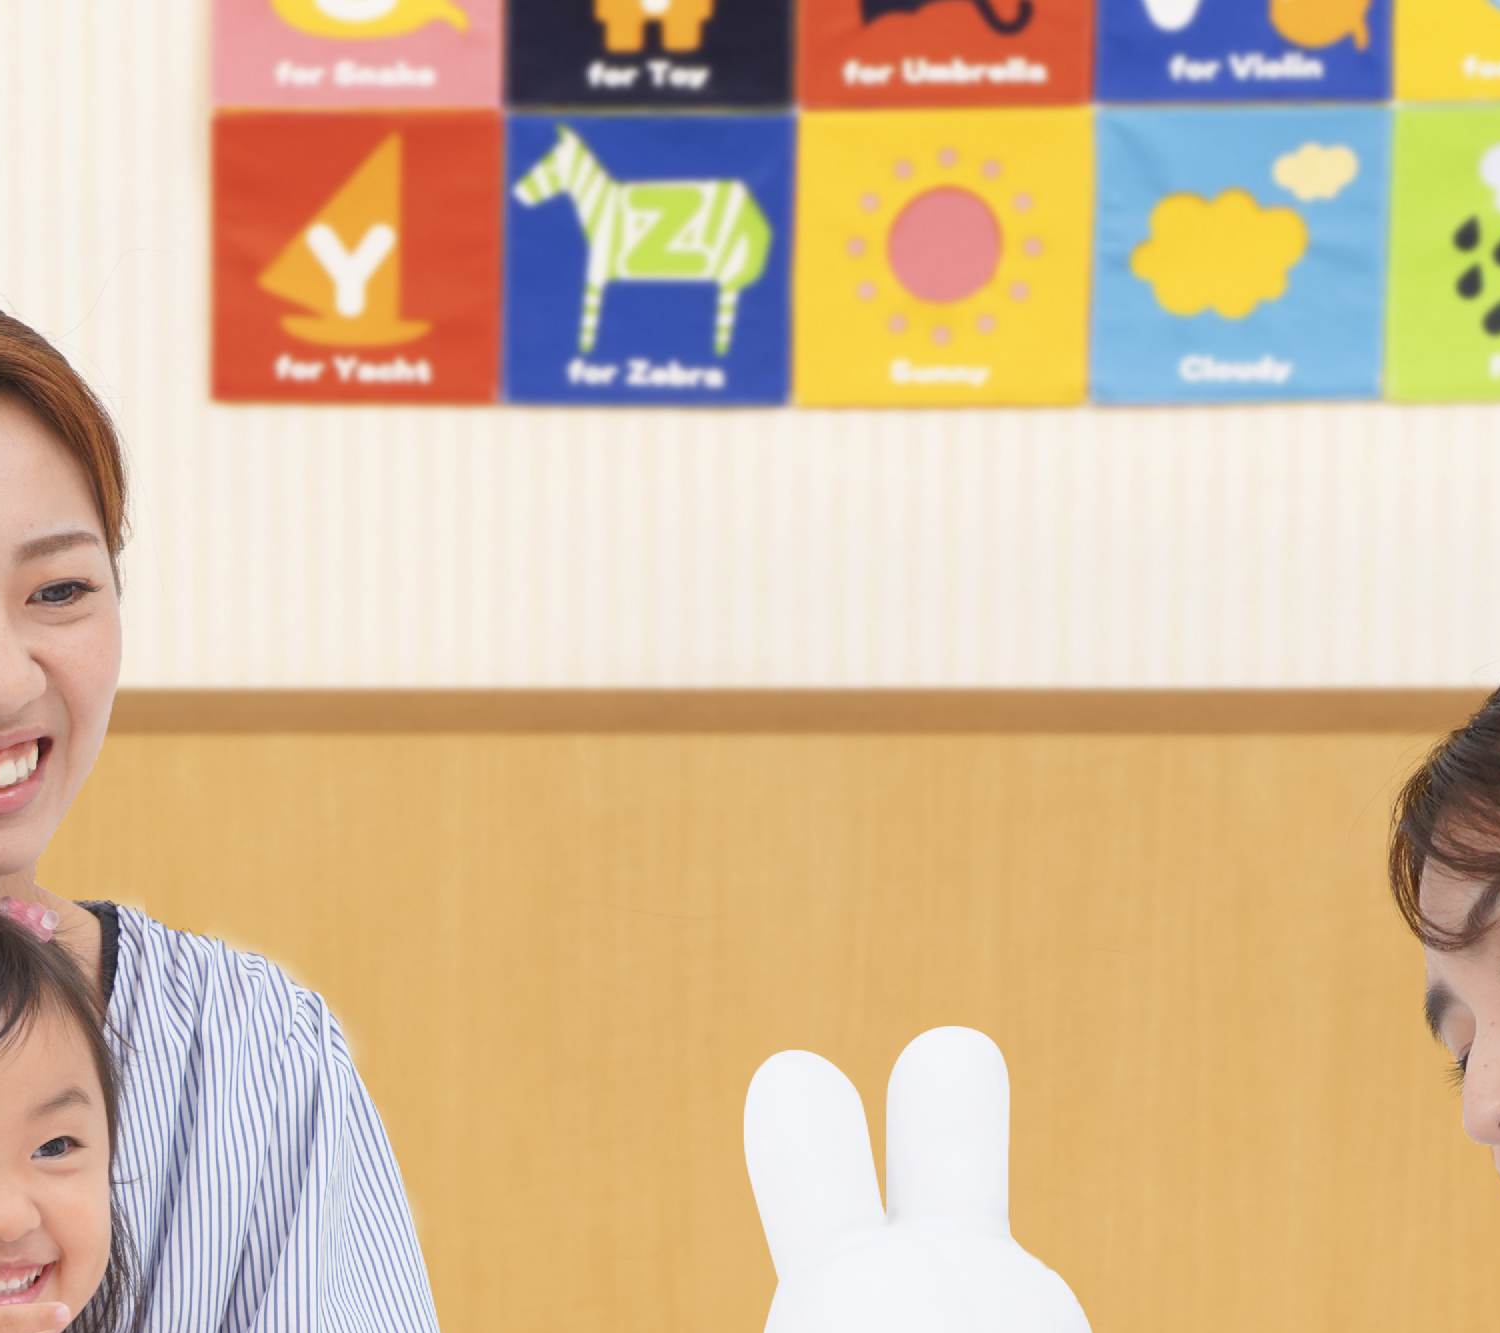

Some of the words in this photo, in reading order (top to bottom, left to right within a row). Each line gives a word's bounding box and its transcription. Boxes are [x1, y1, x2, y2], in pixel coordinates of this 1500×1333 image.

[274, 60, 325, 87] for
[332, 59, 437, 88] Snake
[586, 60, 638, 88] for
[646, 58, 709, 90] Toy
[841, 59, 893, 86] for
[900, 56, 1048, 85] Umbrella
[1168, 54, 1221, 82] for
[1227, 51, 1325, 80] Violin
[623, 186, 709, 277] Z
[304, 222, 397, 319] Y
[274, 353, 325, 381] for
[332, 355, 432, 385] Yacht
[566, 357, 618, 385] for
[625, 358, 725, 389] Zebra
[888, 357, 990, 387] Sunny
[1177, 354, 1293, 384] Cloudy
